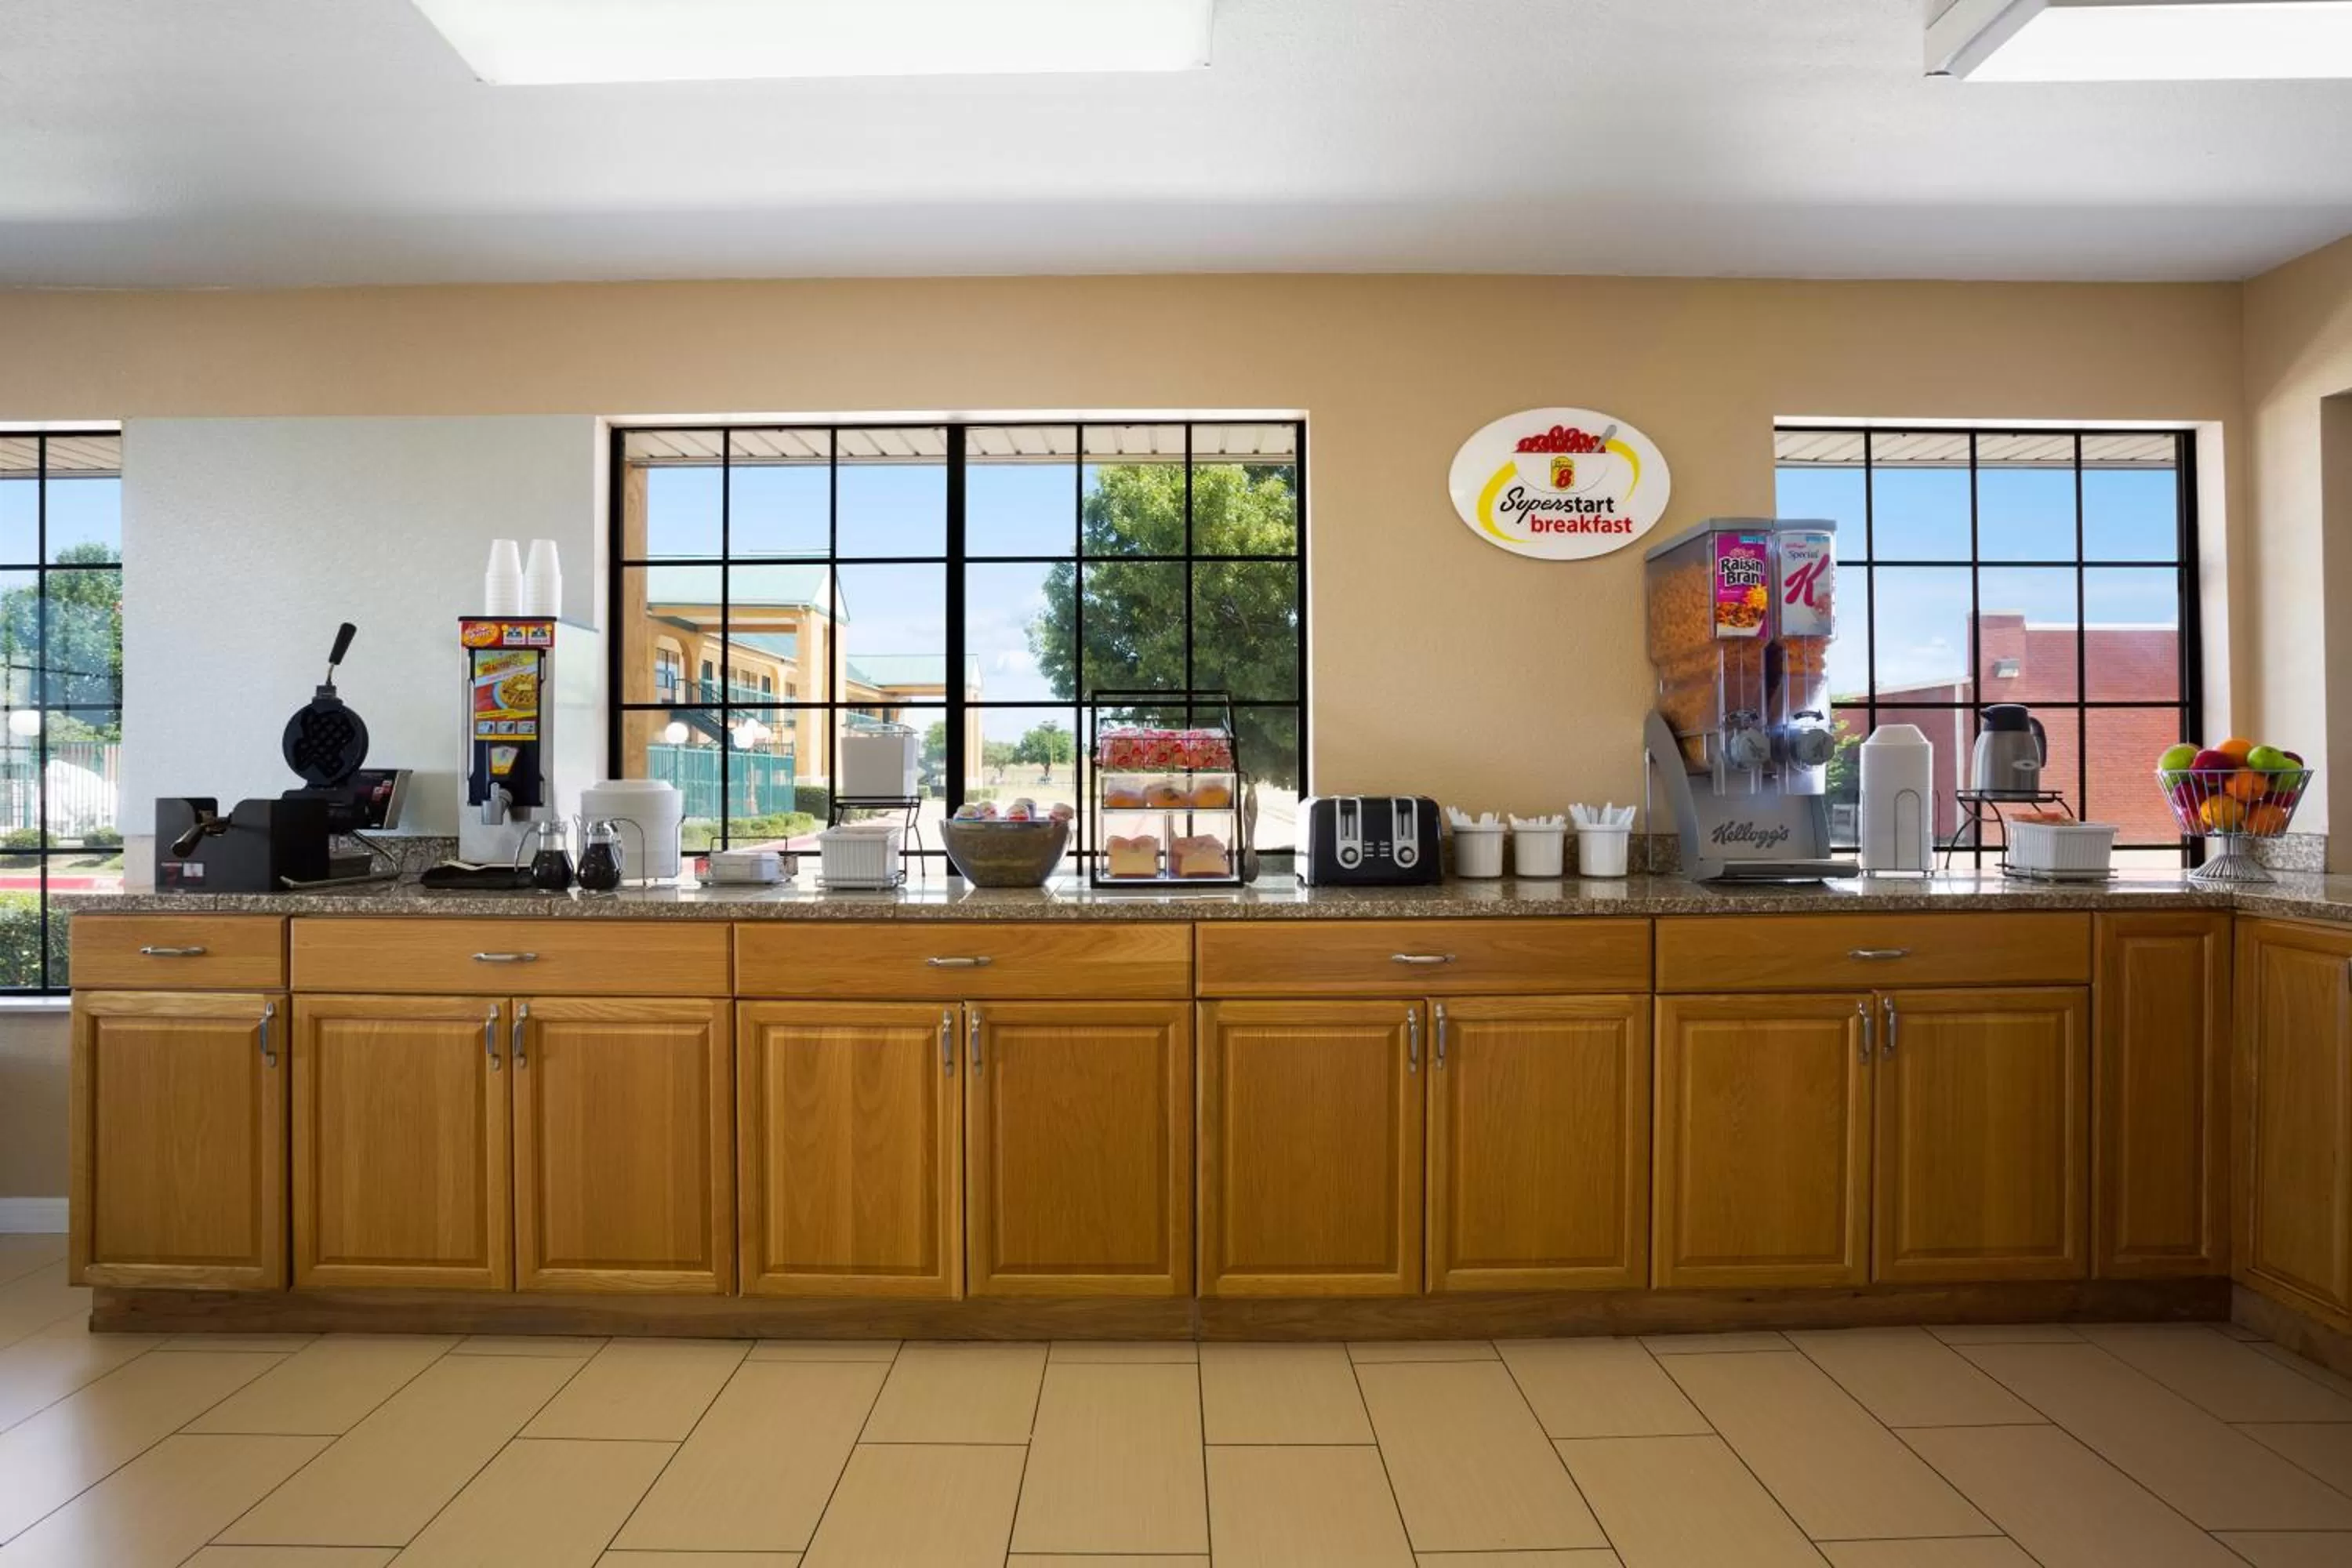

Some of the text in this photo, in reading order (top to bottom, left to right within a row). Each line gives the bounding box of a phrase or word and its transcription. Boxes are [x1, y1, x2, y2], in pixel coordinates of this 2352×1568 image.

[1555, 468, 1573, 490] 8
[1530, 514, 1633, 534] breakfast
[1720, 557, 1763, 573] Raisin
[1788, 550, 1819, 561] Special
[1726, 571, 1760, 586] Bran
[1784, 554, 1831, 607] K
[1711, 821, 1790, 849] Kellogg's
